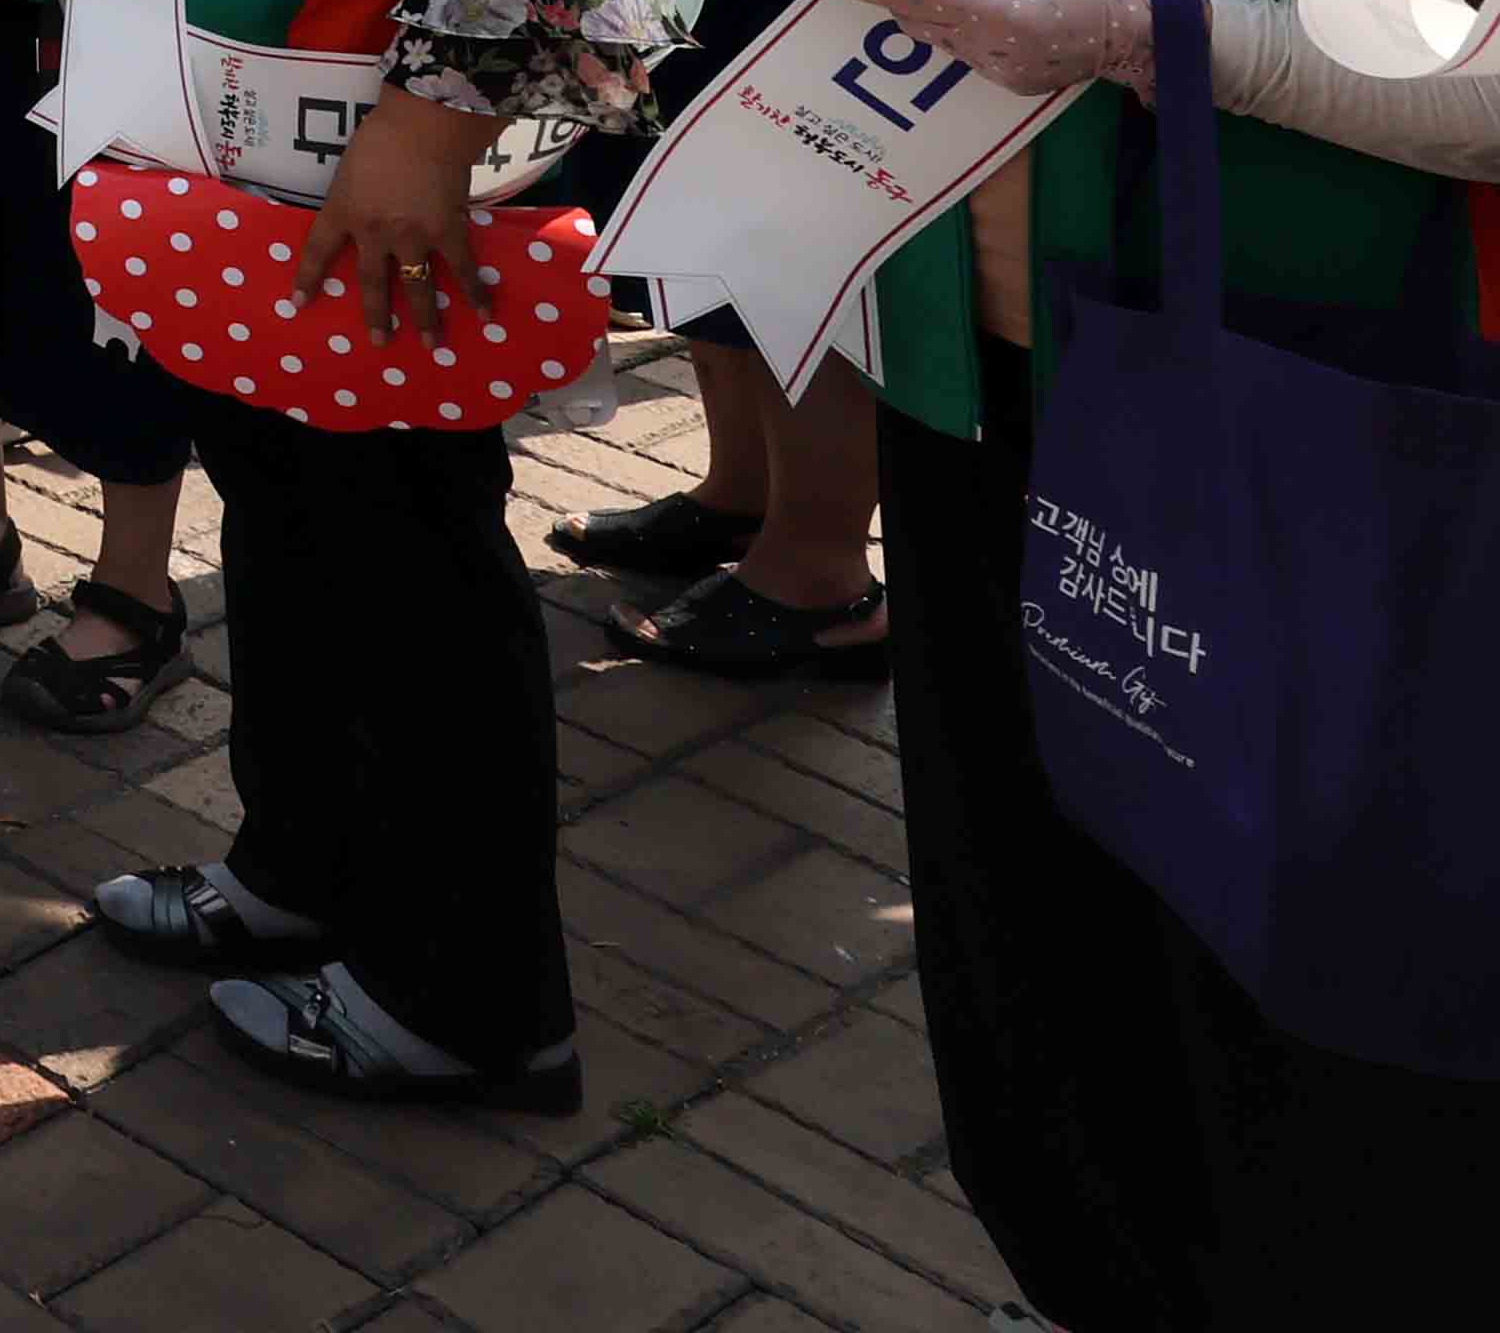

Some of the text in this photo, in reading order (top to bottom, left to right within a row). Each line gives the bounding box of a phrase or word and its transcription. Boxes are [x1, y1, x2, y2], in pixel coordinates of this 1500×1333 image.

[793, 124, 865, 174] 행복도시
[863, 167, 915, 205] 동구
[1030, 495, 1107, 568] 고객님
